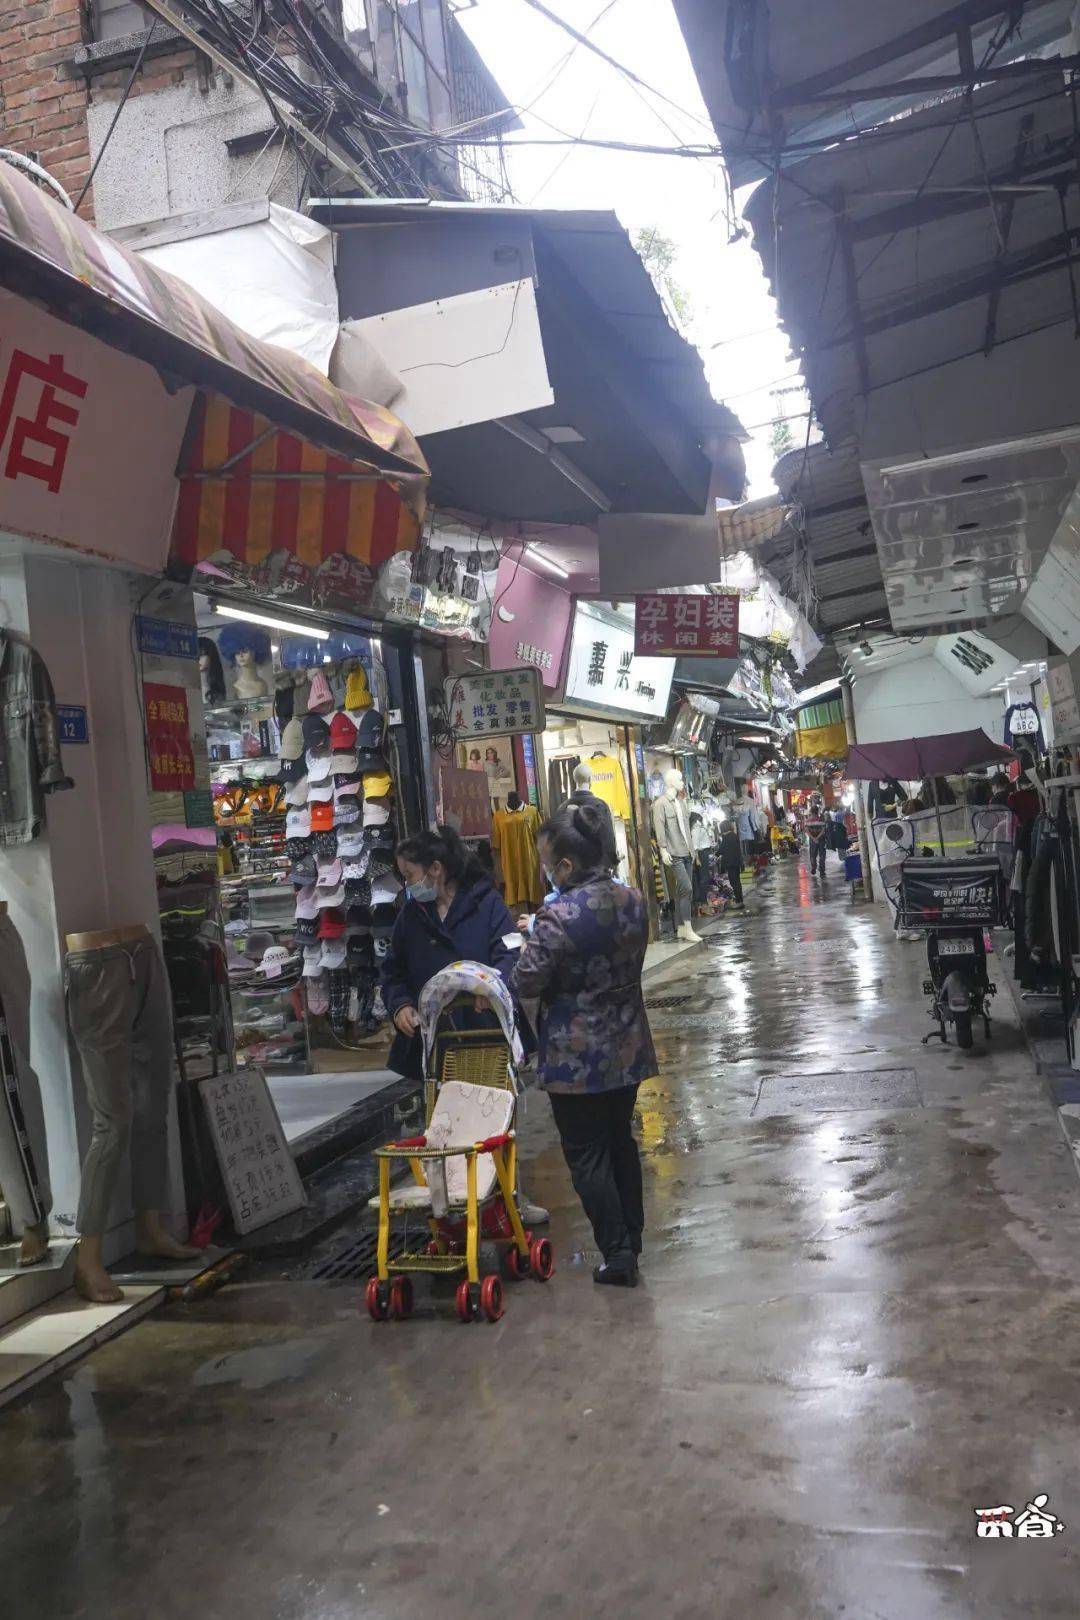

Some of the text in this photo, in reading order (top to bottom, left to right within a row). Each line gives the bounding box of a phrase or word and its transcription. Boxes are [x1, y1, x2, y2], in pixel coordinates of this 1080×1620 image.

[0, 348, 88, 494] 店
[640, 596, 735, 630] 孕妇装
[640, 630, 734, 646] 休闲装
[472, 700, 531, 718] 批发零售
[63, 722, 76, 737] 12
